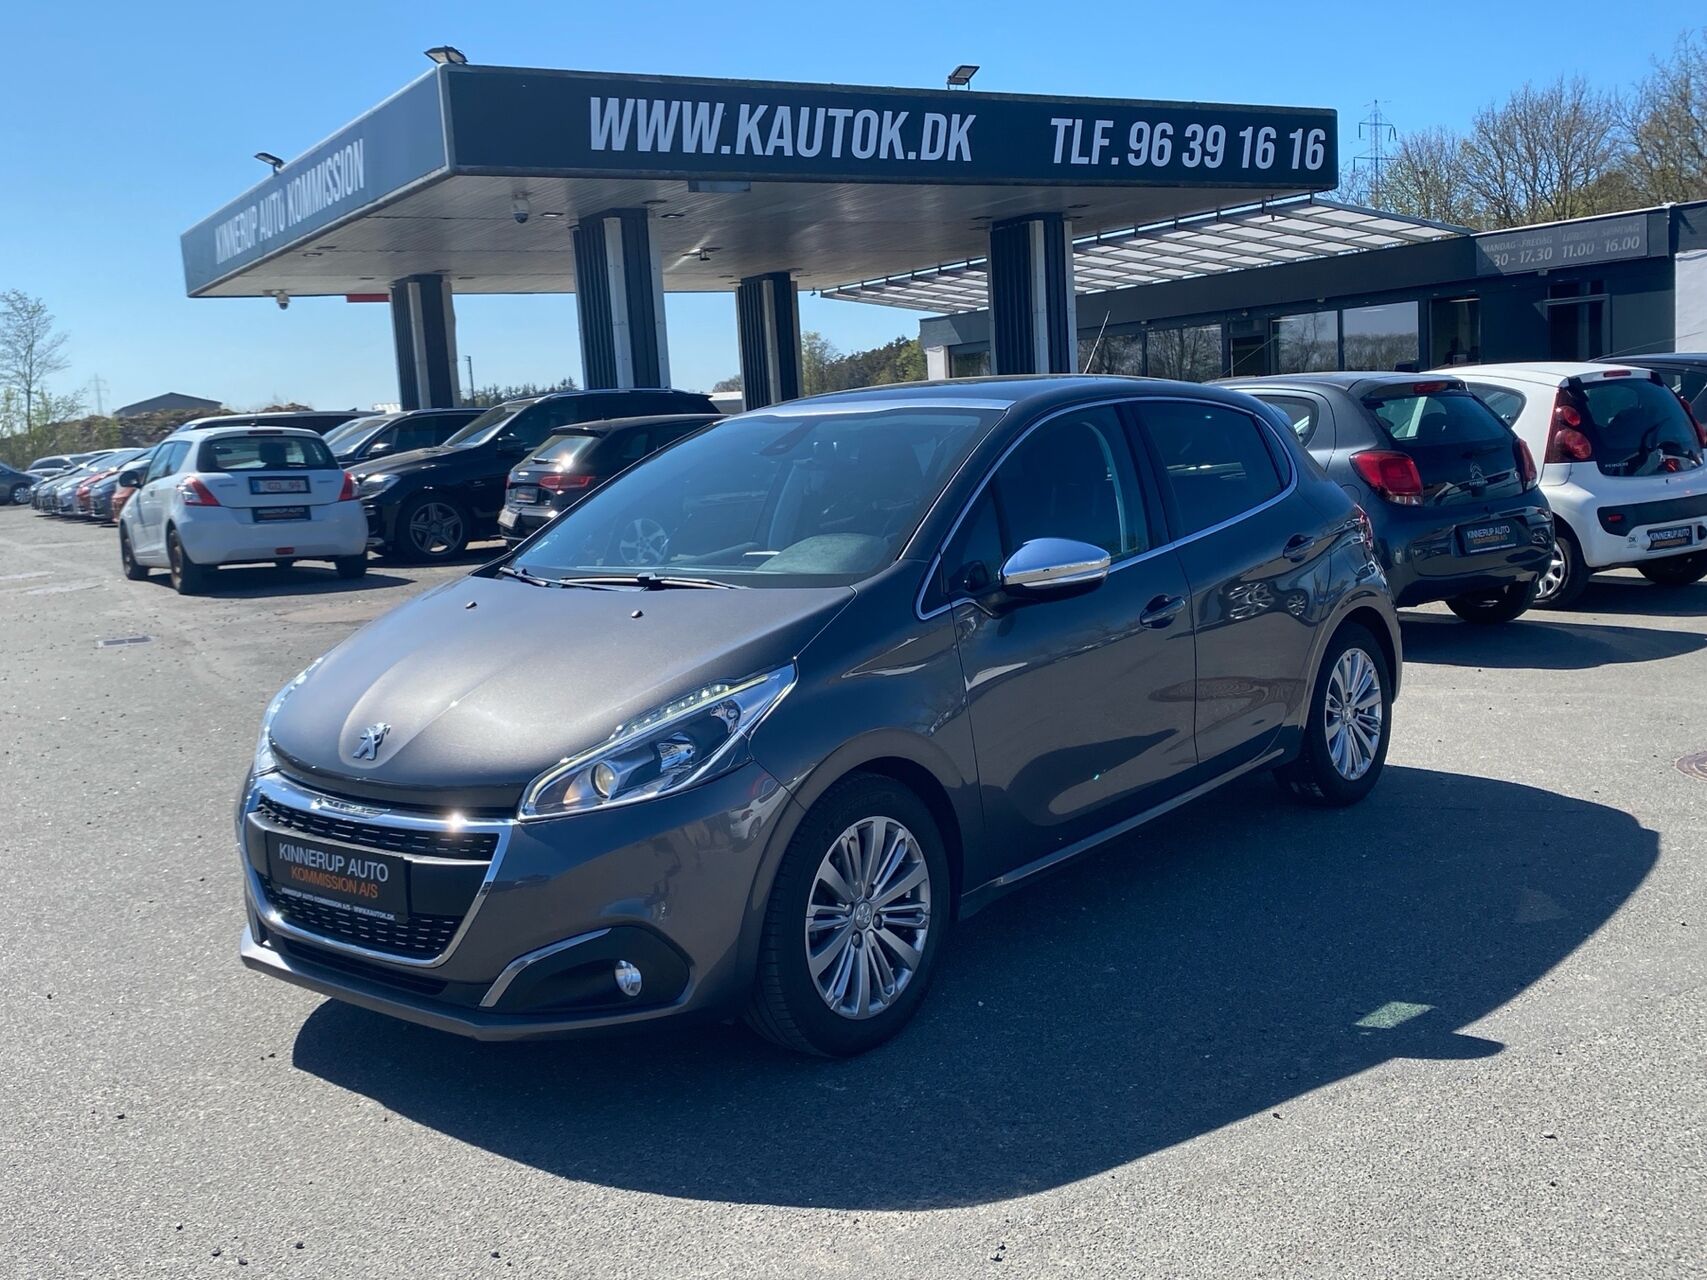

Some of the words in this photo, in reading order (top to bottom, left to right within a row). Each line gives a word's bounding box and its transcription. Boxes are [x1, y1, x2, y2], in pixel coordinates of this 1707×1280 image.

[590, 97, 977, 162] WWW.KAUTOK.DK
[1050, 117, 1119, 166] TLF.
[1127, 121, 1174, 167] 96
[1182, 123, 1226, 169] 39
[1239, 126, 1277, 170] 16
[1289, 128, 1326, 171] 16
[215, 205, 258, 265] KINNERUP
[259, 188, 286, 242] AUTO
[287, 138, 364, 228] KOMMISSION
[1520, 246, 1553, 264] 17.30
[1562, 241, 1595, 259] 11.00
[1605, 235, 1641, 253] 16.00
[1495, 525, 1510, 535] AUTO
[279, 843, 345, 873] KINNERUP
[347, 858, 389, 882] AUTO
[290, 866, 357, 895] KOMMISSION
[359, 881, 378, 899] A/S
